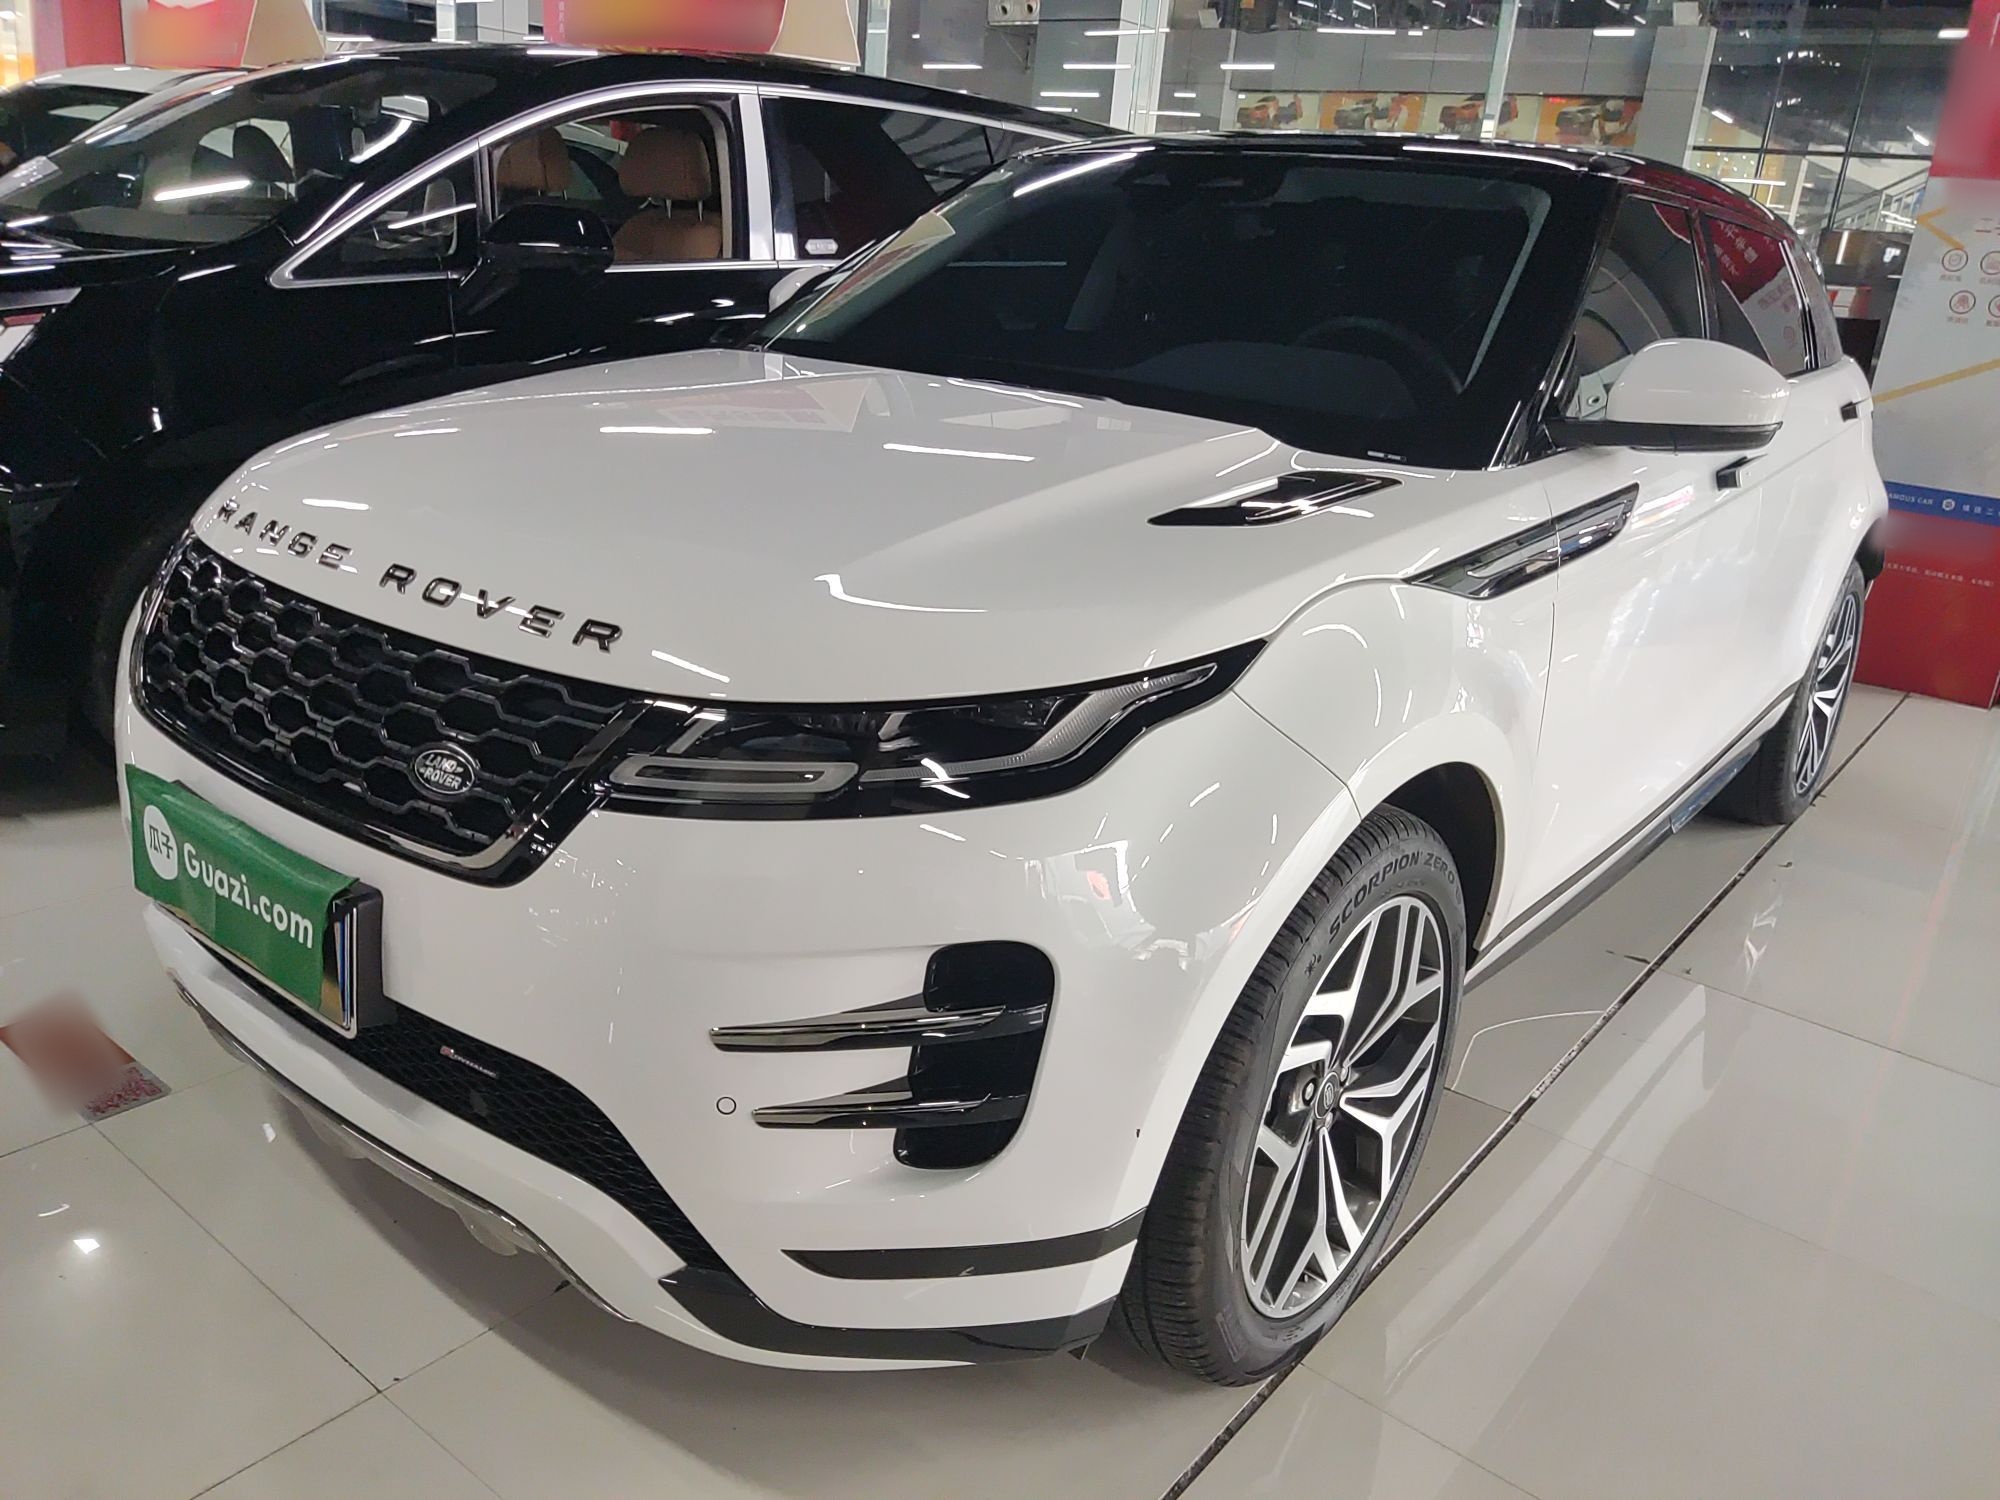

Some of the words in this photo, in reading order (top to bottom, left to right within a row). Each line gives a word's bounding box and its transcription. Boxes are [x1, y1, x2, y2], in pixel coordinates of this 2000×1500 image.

[1888, 492, 1915, 502] AMOUS
[217, 498, 353, 571] RANGE
[379, 563, 623, 654] ROVER
[423, 767, 462, 790] ROVER
[425, 754, 457, 773] LAND
[149, 824, 174, 860] 瓜子
[183, 842, 313, 949] Guazi.com
[1328, 850, 1421, 945] SCORPION
[1423, 852, 1455, 885] ZERO
